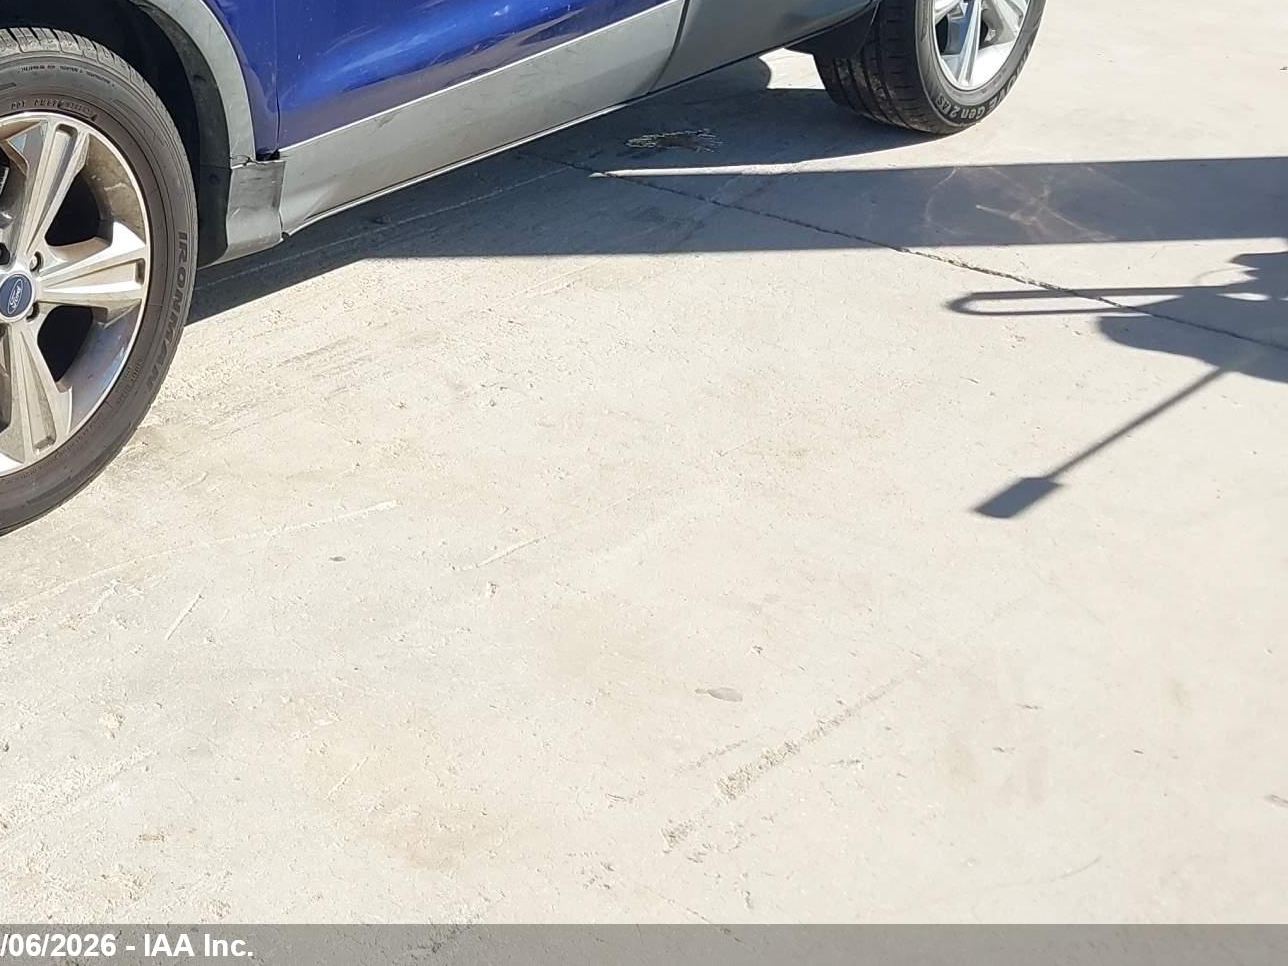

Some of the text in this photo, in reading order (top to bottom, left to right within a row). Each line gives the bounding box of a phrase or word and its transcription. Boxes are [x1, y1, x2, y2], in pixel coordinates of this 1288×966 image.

[949, 106, 960, 118] 2
[960, 106, 985, 120] Gen
[147, 231, 188, 389] IRONMAN
